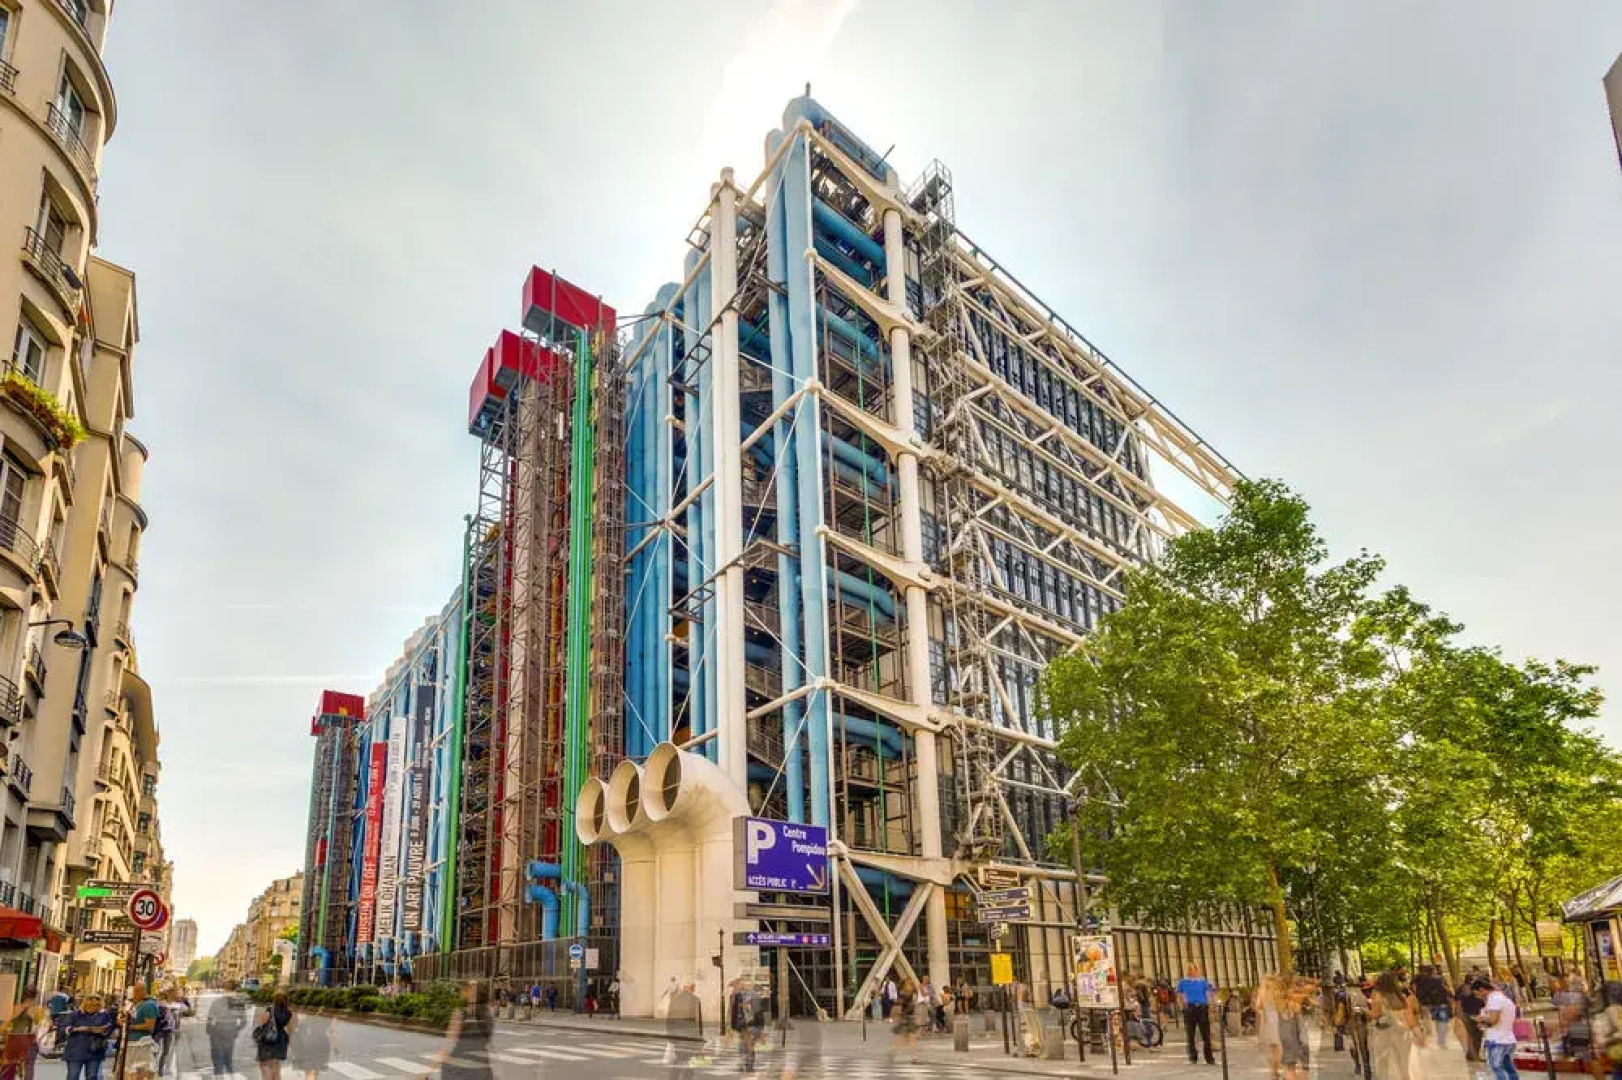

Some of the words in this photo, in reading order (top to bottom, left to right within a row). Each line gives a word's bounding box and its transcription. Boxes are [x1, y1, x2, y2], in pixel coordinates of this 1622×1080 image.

[747, 820, 776, 864] P
[782, 825, 807, 840] Centre
[792, 840, 825, 856] Pompidou
[407, 841, 423, 883] PAUVRE
[405, 887, 419, 908] ART
[136, 899, 155, 916] 30
[379, 902, 393, 935] MELIK
[404, 911, 418, 927] UN
